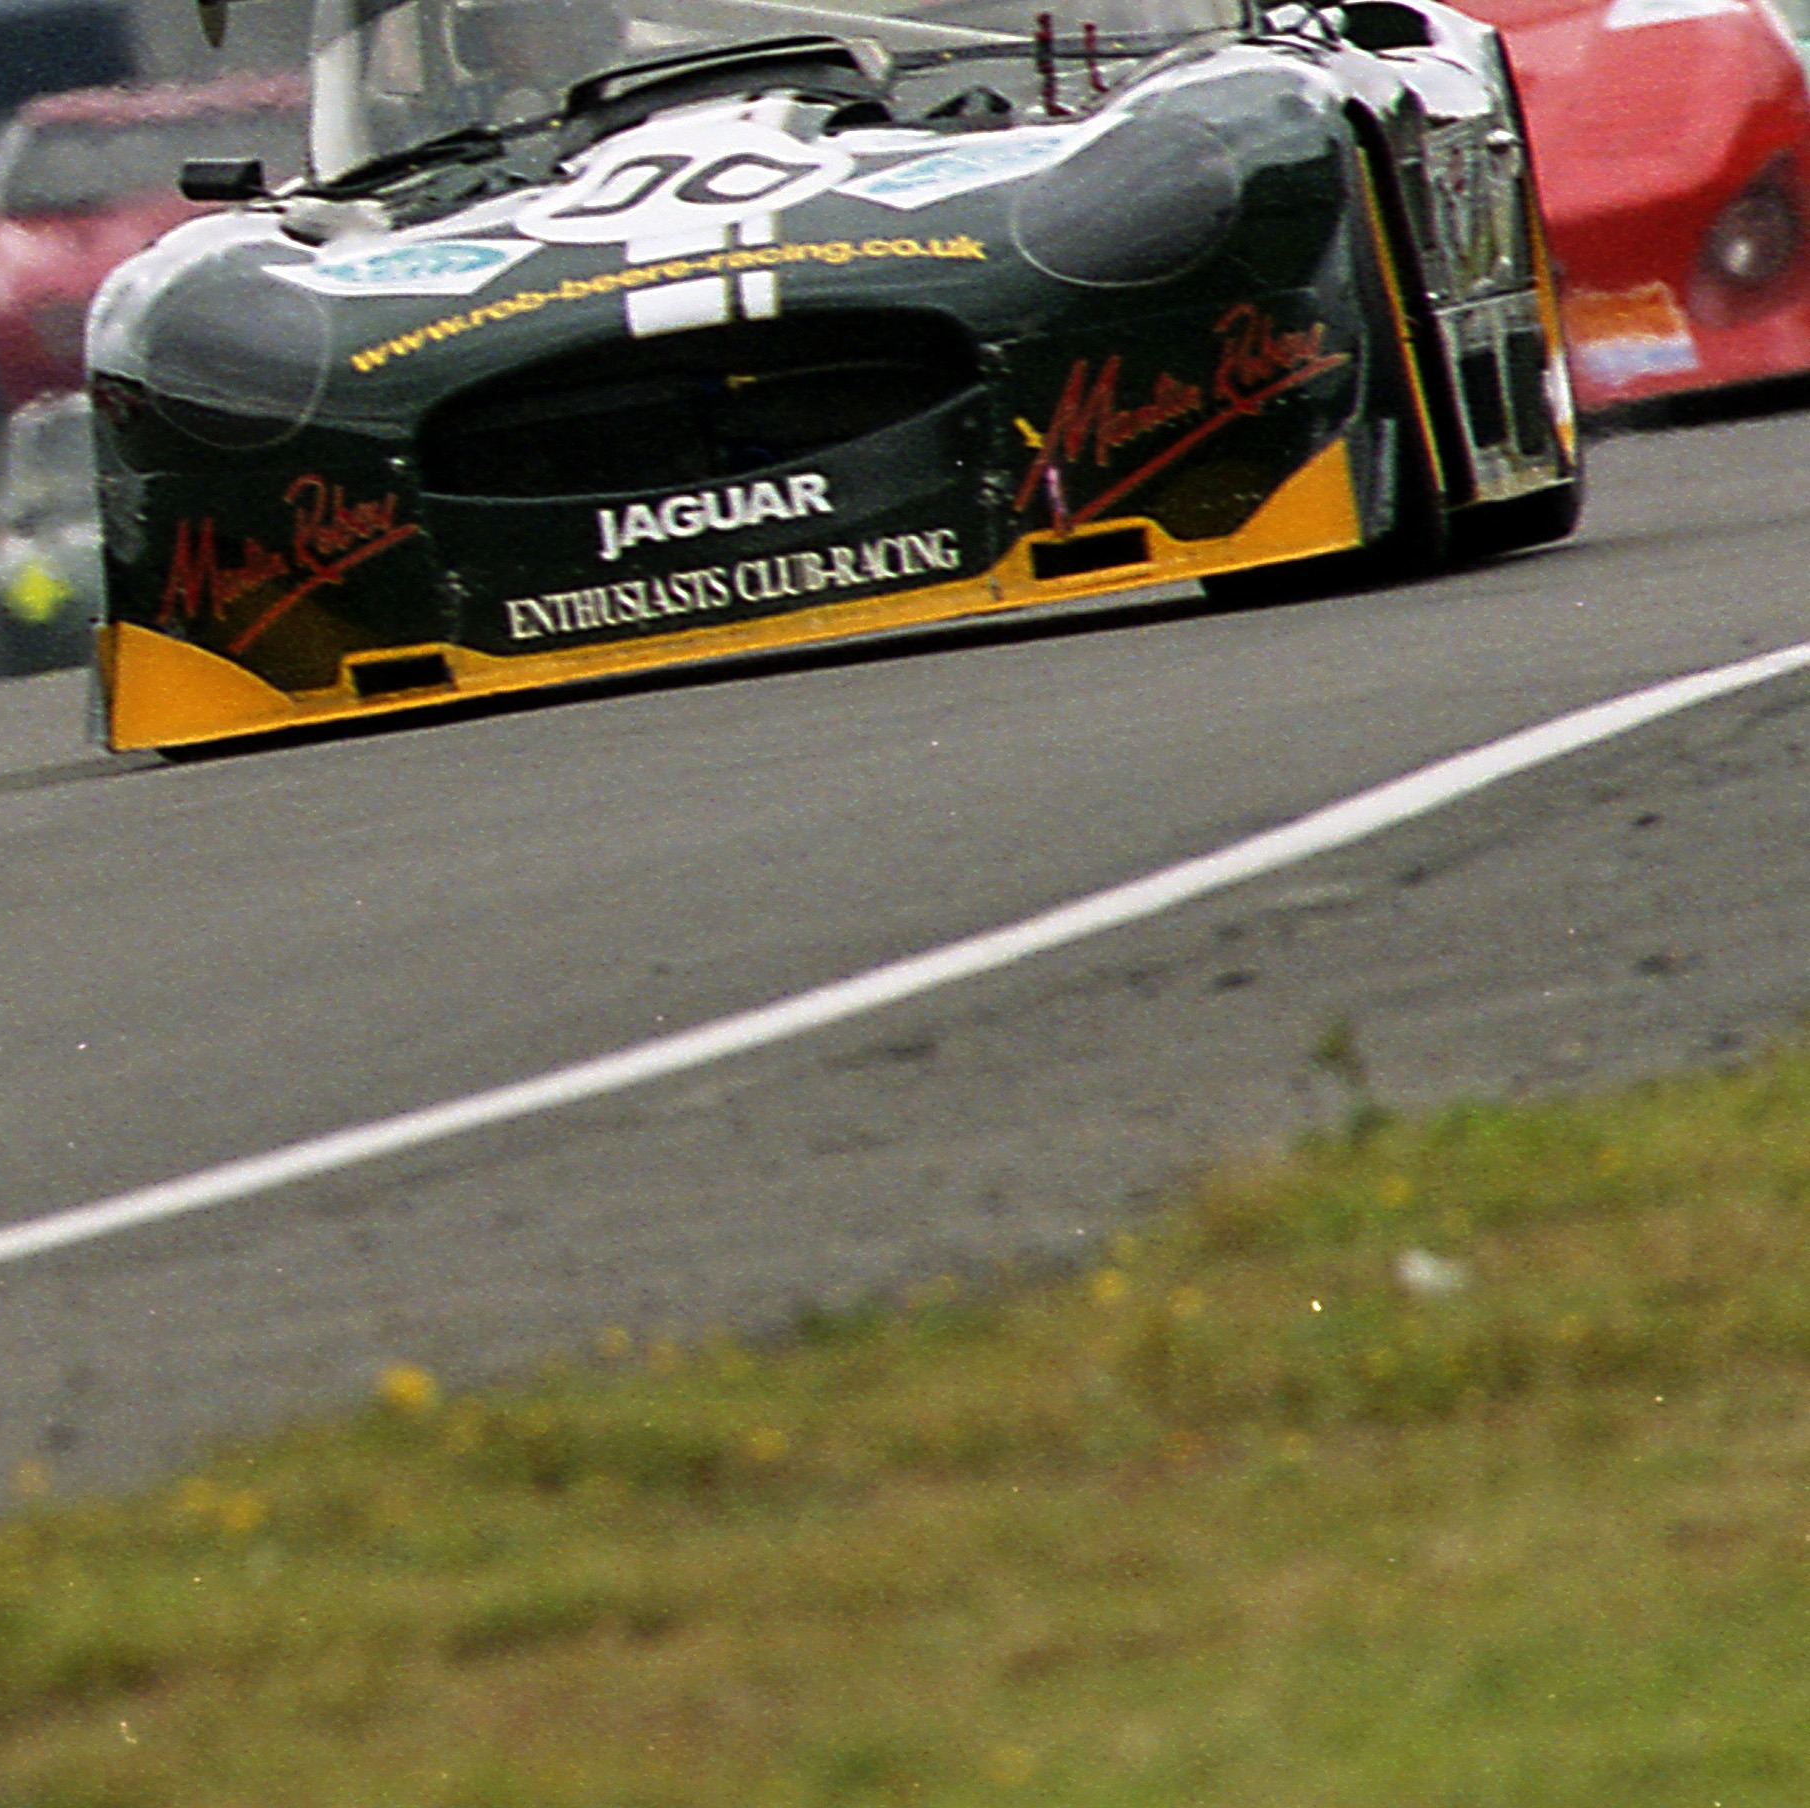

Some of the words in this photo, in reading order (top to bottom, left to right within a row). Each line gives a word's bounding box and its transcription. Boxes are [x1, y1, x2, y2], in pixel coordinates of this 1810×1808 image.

[598, 473, 834, 561] JAGUAR
[506, 573, 729, 642] ENTHUSIASTS
[735, 527, 961, 604] CLUB-RACING
